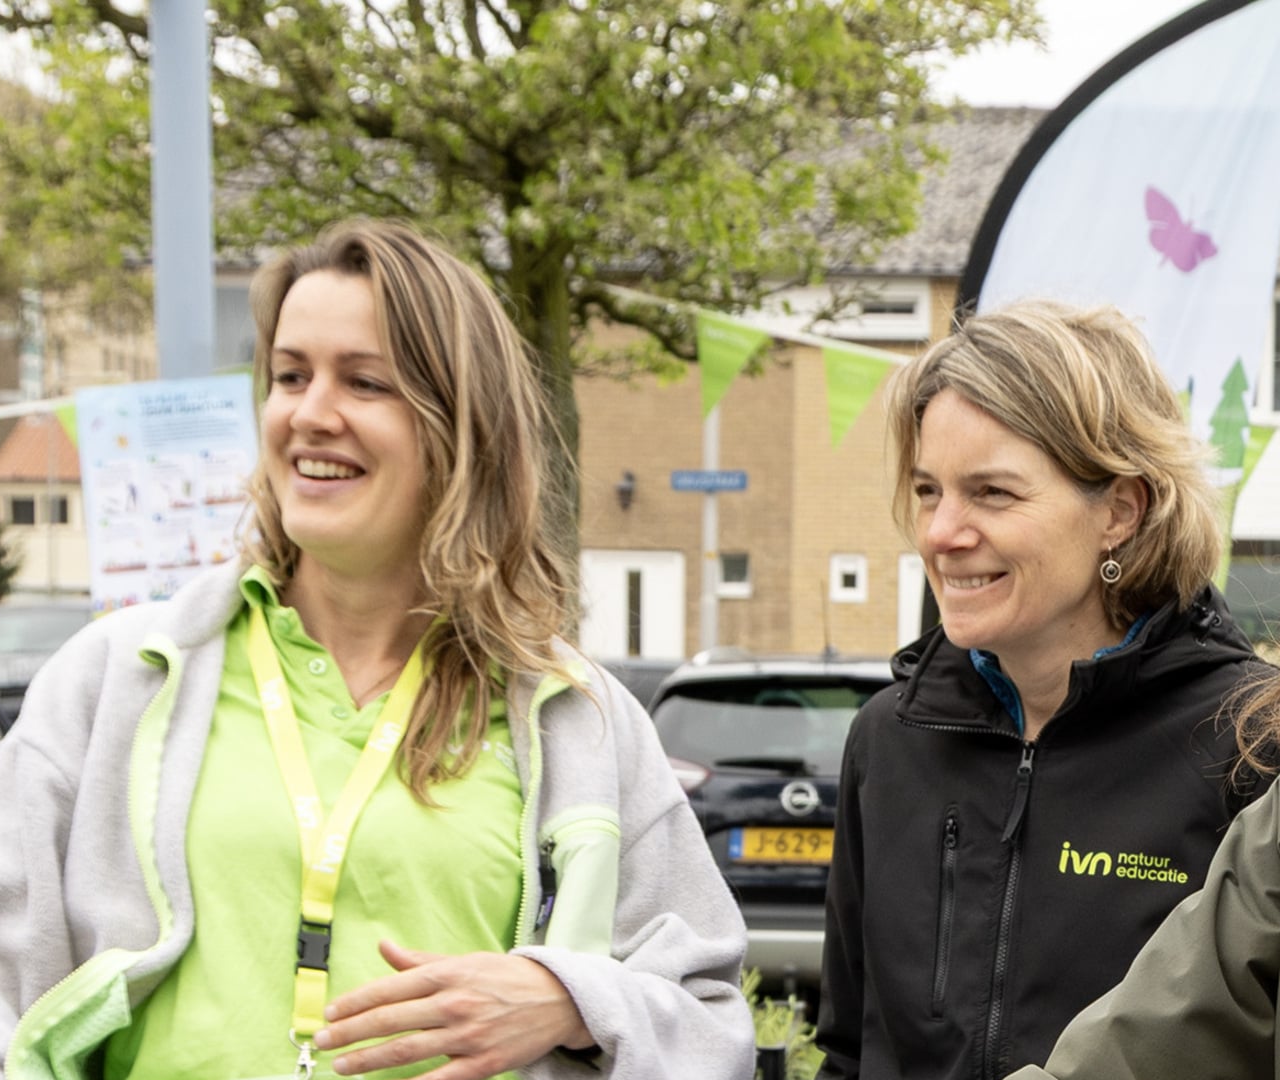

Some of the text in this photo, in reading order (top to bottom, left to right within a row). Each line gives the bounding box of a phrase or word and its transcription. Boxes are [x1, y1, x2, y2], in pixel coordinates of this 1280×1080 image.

[1059, 841, 1112, 876] ivn
[1117, 852, 1171, 868] natuur
[1116, 865, 1189, 884] educatie
